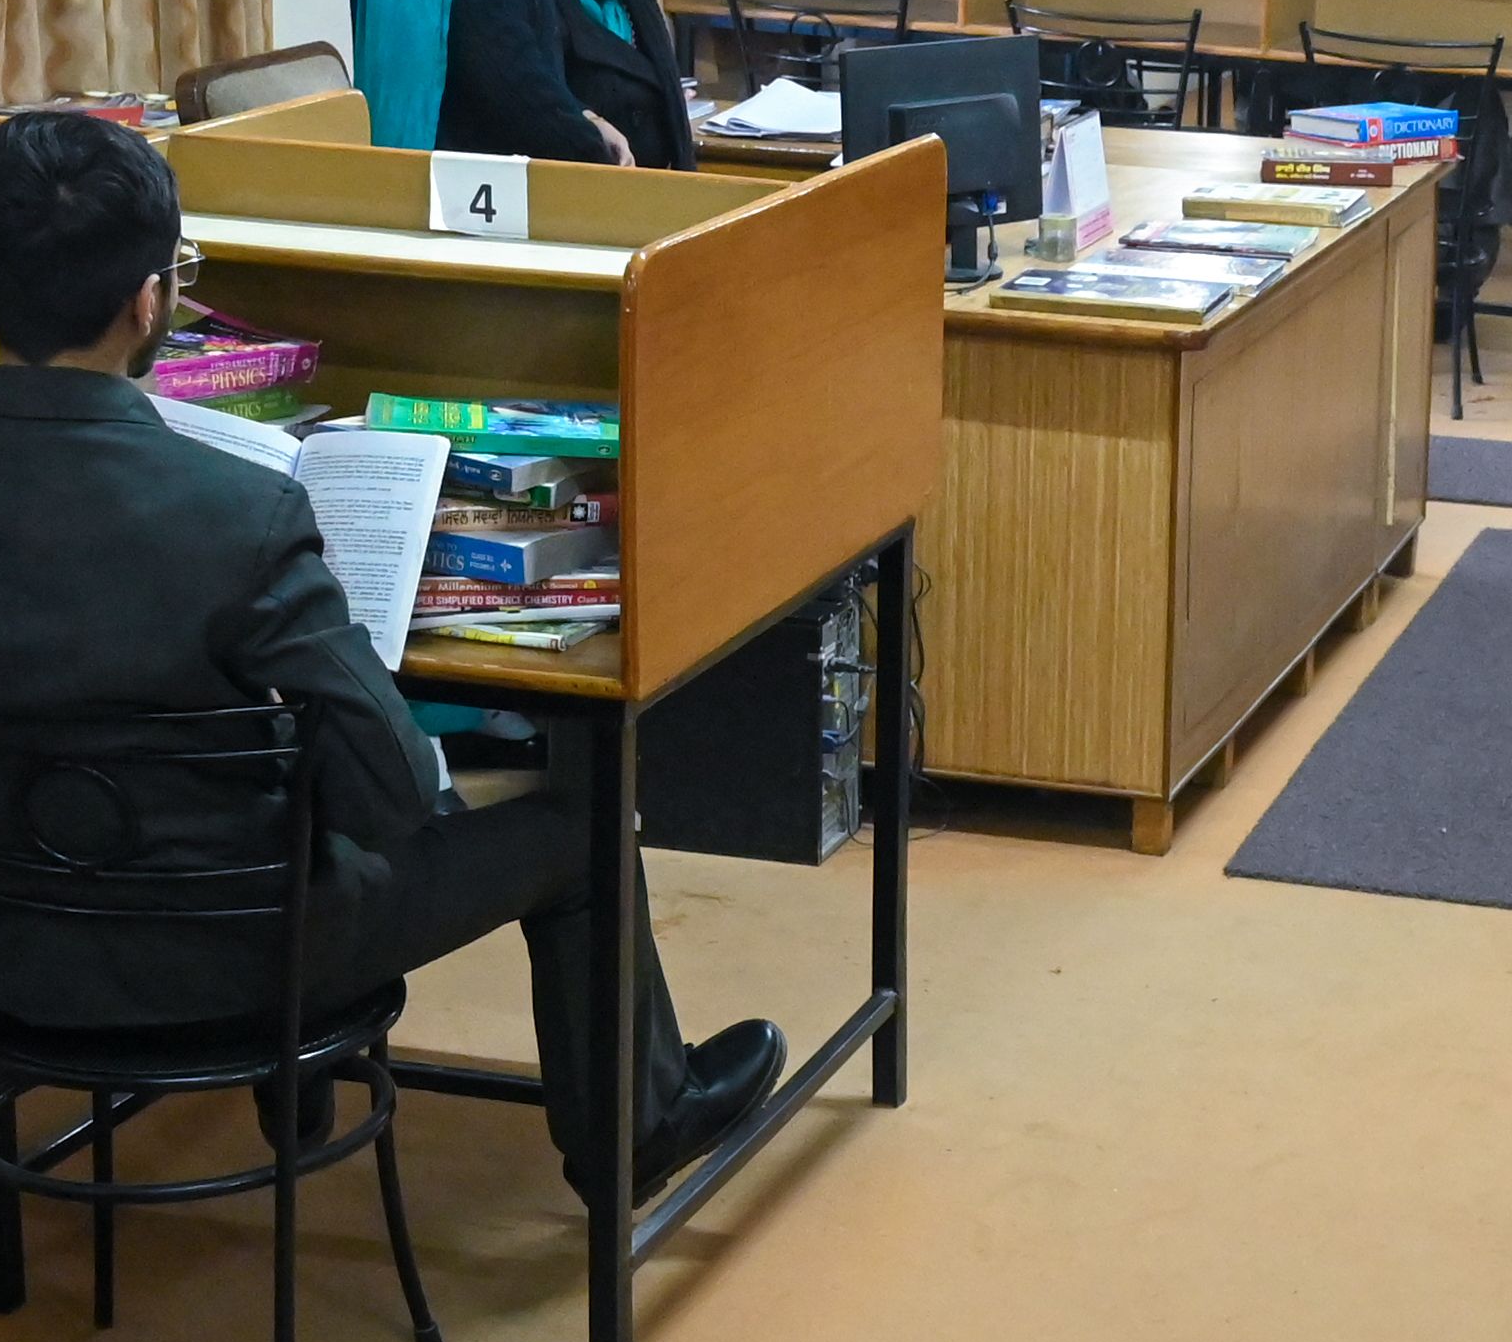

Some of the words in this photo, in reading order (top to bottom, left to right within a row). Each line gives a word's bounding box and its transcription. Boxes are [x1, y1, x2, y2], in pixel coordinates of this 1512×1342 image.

[1393, 117, 1455, 134] DICTIONARY
[1378, 140, 1439, 160] DICTIONARY
[469, 184, 497, 223] 4
[211, 367, 266, 390] PHYSICS
[436, 595, 484, 606] SIMPLIFIED
[485, 595, 521, 605] SCIENCE
[525, 594, 574, 605] CHEMISTRY
